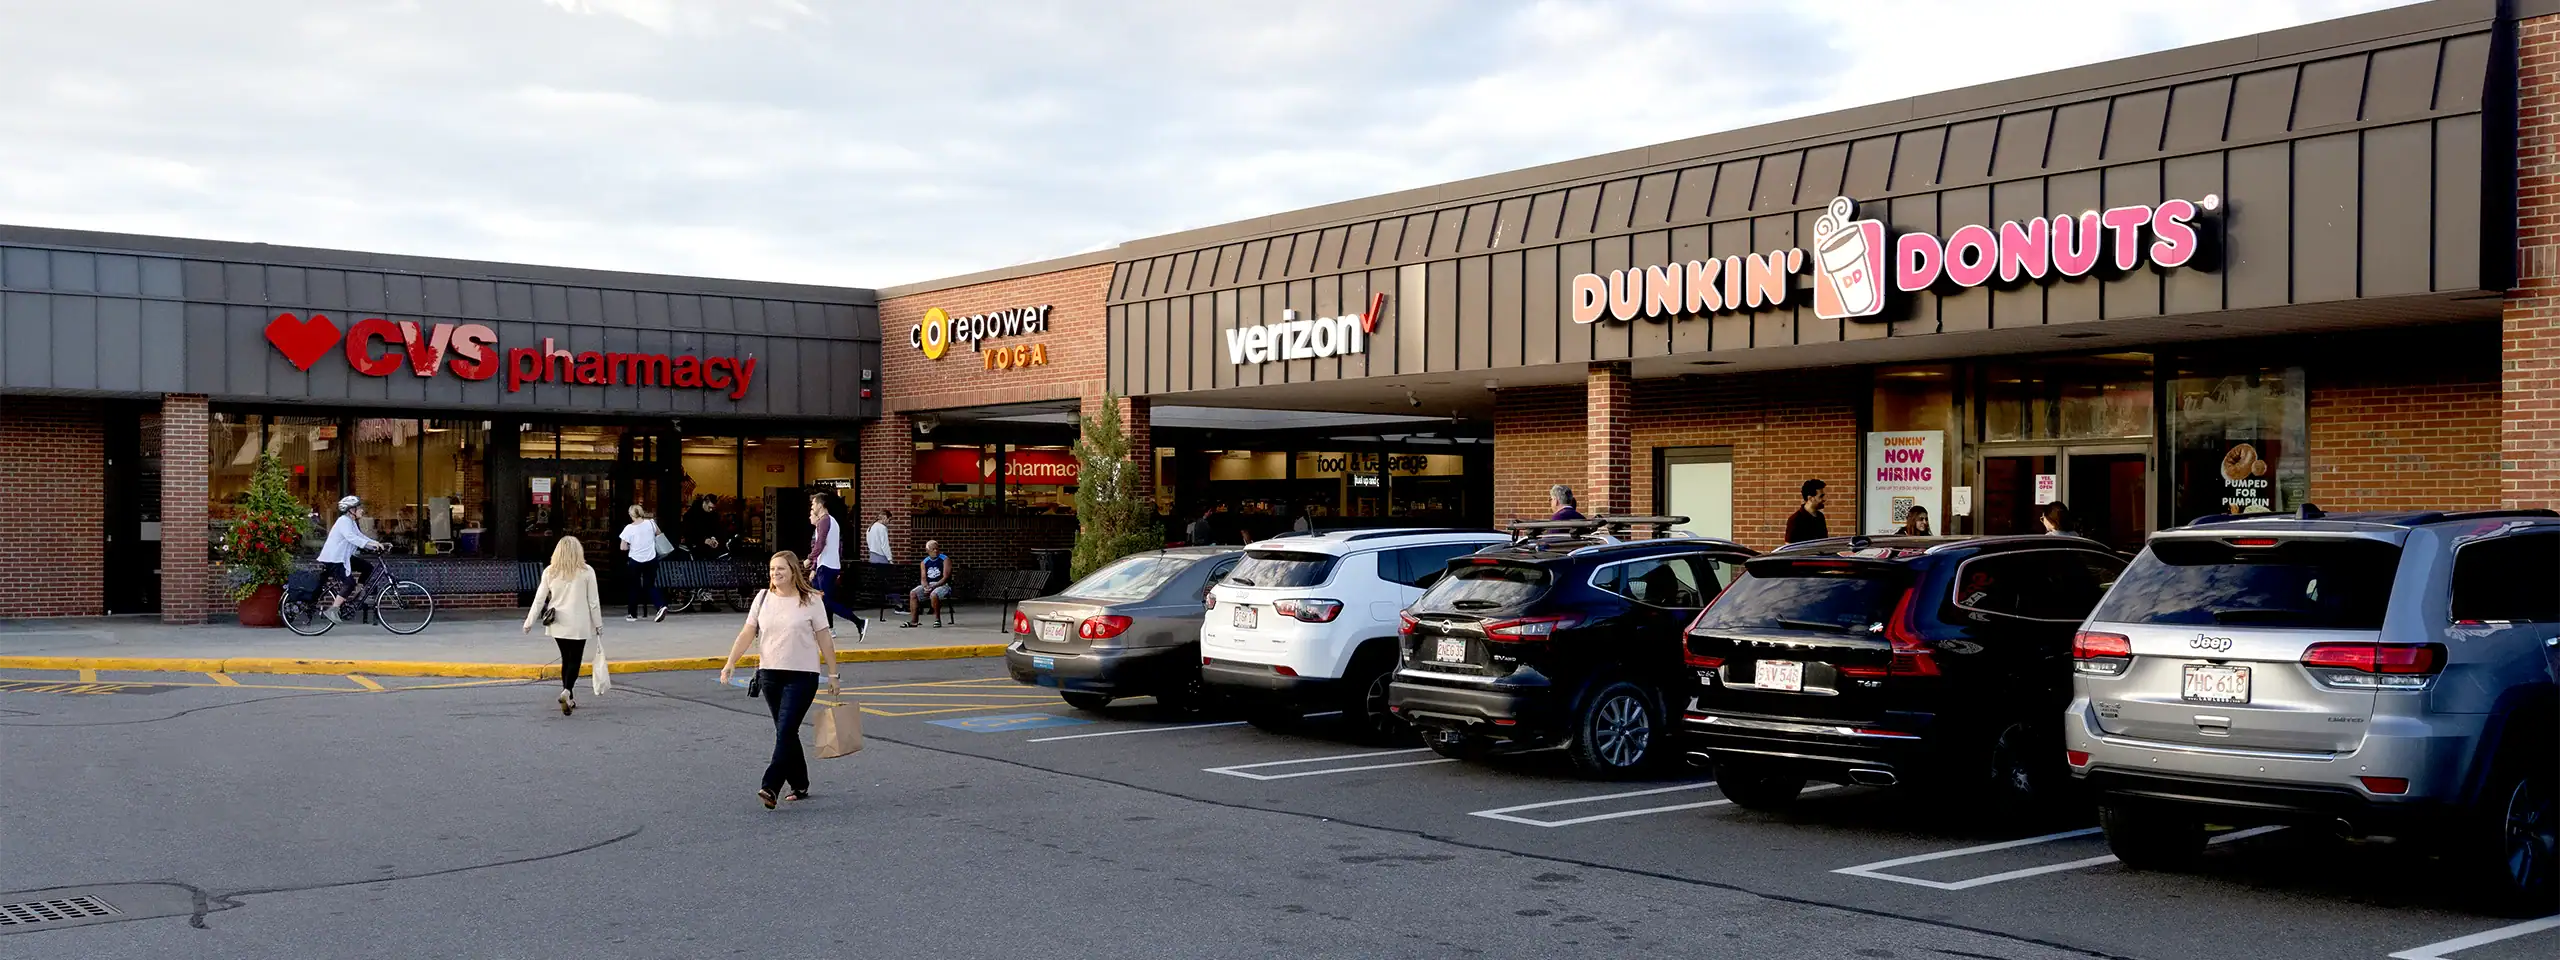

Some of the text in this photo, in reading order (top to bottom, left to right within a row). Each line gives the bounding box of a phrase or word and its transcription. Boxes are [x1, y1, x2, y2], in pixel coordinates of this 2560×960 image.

[1572, 198, 2198, 325] DUNKIN' DONUTS
[910, 304, 1050, 355] corepower
[1225, 308, 1364, 365] verizon
[345, 317, 757, 400] CVS pharmacy
[983, 343, 1048, 370] YOGA
[1317, 452, 1346, 473] food
[1363, 452, 1428, 475] beerage
[1884, 448, 1925, 464] NOW
[1876, 466, 1932, 482] HIRING
[2224, 479, 2268, 488] PUMPED
[2222, 498, 2269, 507] PUMPKIN
[2235, 488, 2257, 497] FOR
[765, 494, 773, 552] ELSIUS
[2190, 634, 2232, 652] Jeep
[2186, 673, 2245, 694] 7HC 618
